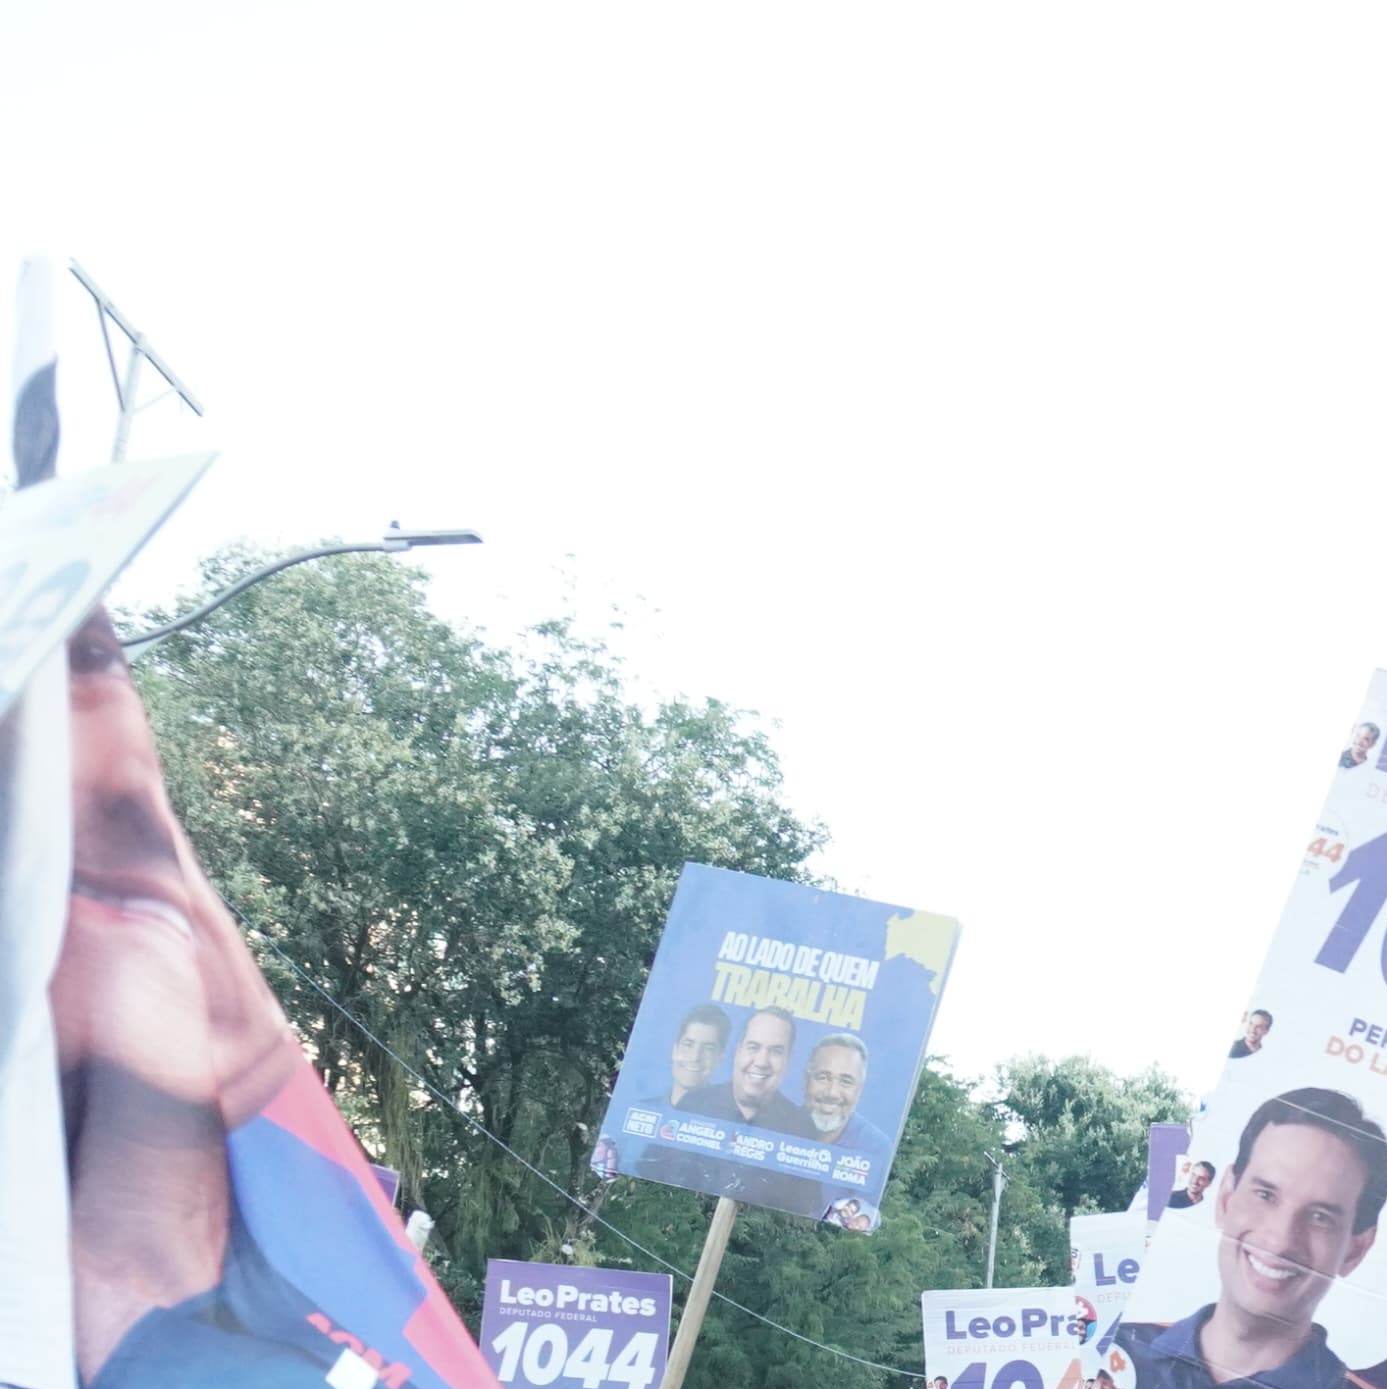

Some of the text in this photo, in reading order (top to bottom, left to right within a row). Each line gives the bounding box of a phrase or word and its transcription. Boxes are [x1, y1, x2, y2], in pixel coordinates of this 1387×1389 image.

[718, 931, 880, 989] AO LADO DE QUEM
[711, 962, 867, 1031] TRABALHA
[1325, 1034, 1363, 1066] DO
[679, 1122, 726, 1141] ANGELO
[676, 1132, 721, 1150] CORONEL
[776, 1151, 830, 1173] Guerrilha
[837, 1154, 871, 1171] JOÃO
[831, 1169, 866, 1186] ROMA
[499, 1306, 598, 1323] DEPUTADO FEDERAL
[947, 1342, 1017, 1356] DEPUTADO
